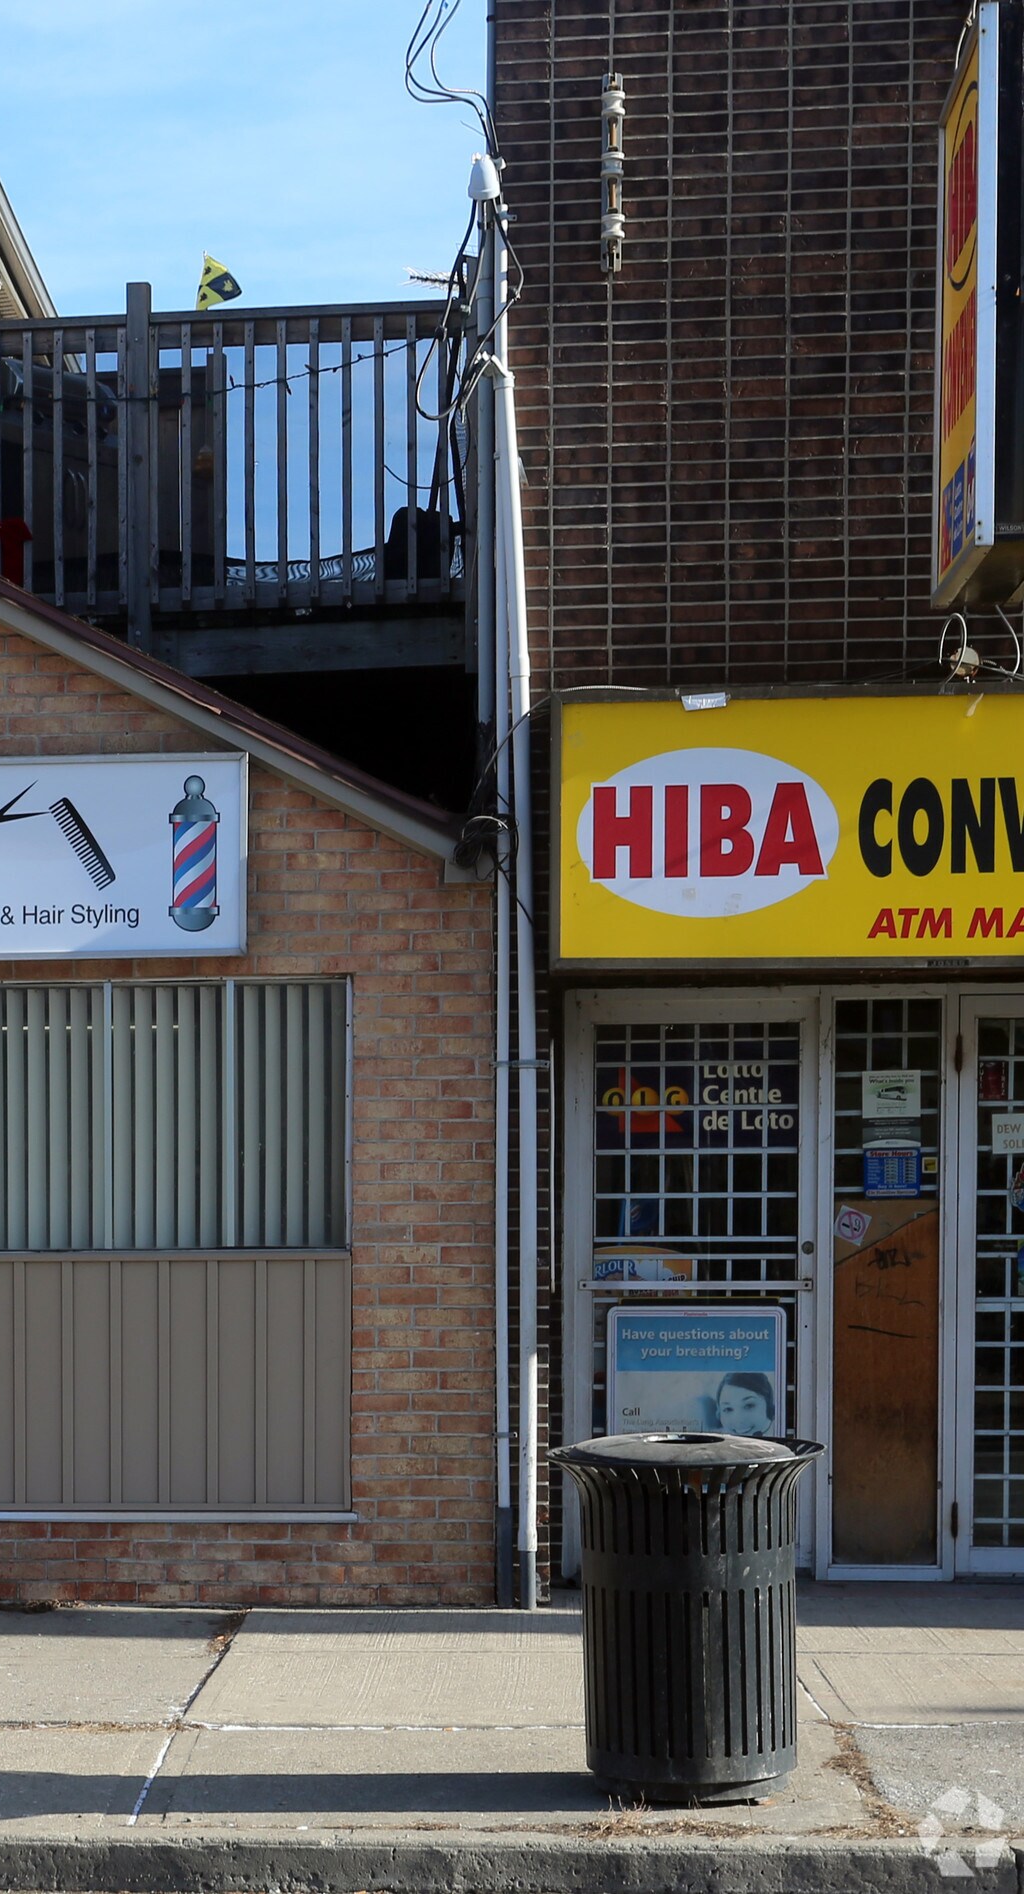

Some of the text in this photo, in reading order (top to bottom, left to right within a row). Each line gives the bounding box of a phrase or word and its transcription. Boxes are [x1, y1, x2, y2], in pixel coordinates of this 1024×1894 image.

[948, 103, 977, 275] HIB
[592, 783, 825, 879] HIBA
[0, 905, 15, 925] &
[22, 904, 65, 925] Hair
[70, 903, 140, 929] Styling
[866, 907, 1024, 939] ATM MA
[702, 1085, 783, 1105] Centre
[702, 1111, 794, 1131] de Loto
[997, 1124, 1021, 1134] DEW
[1003, 1139, 1024, 1149] SOL
[621, 1328, 769, 1343] Have questions about
[640, 1345, 749, 1360] your breathing?
[622, 1407, 640, 1416] Call
